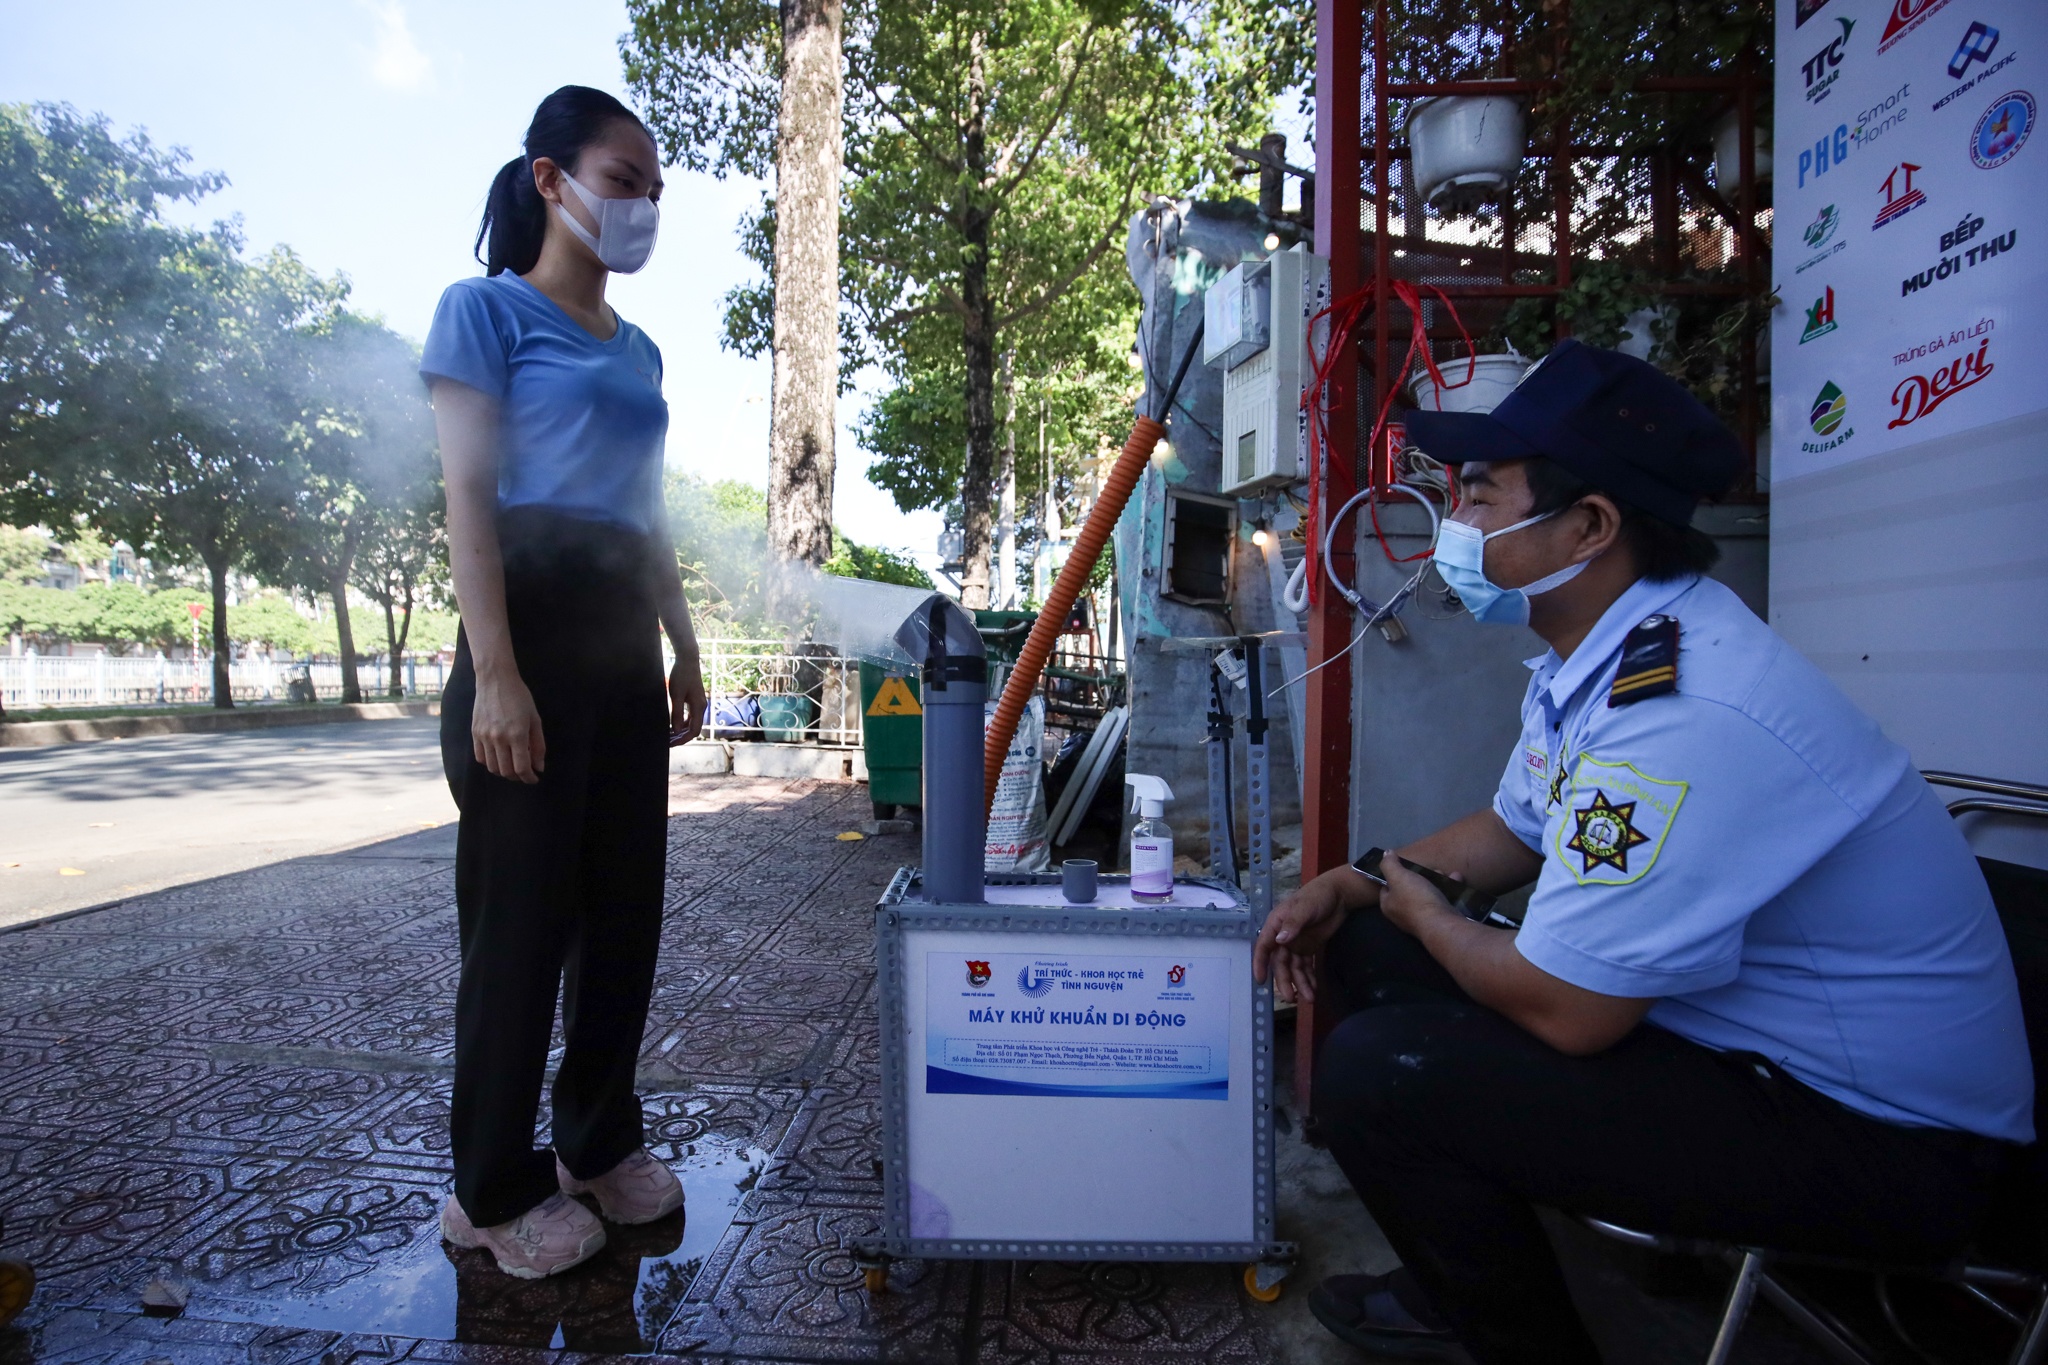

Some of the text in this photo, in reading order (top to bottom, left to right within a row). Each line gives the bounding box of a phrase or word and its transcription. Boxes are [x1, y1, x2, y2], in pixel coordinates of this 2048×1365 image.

[1802, 36, 1844, 88] TTC
[1932, 51, 2017, 112] WESTERN PACIFIC
[1806, 69, 1840, 102] SUGAR
[1857, 82, 1910, 129] Smart
[1858, 107, 1908, 150] Home
[1798, 123, 1848, 189] PHG
[1833, 240, 1846, 254] 175
[1940, 212, 1984, 253] BẾP
[1902, 229, 2016, 298] MƯỜI THU
[1888, 338, 1994, 430] Devi
[1801, 427, 1854, 454] DELIFARM
[1034, 968, 1048, 978] TRÍ
[1050, 968, 1072, 978] THỨC
[1080, 970, 1105, 978] KHOA
[1108, 971, 1125, 981] HỌC
[1128, 968, 1144, 980] TRẺ
[1061, 981, 1123, 992] TÌNH NGUYỆN
[968, 1005, 1186, 1030] MÁY KHỬ KHUẨN DI ĐỘNG
